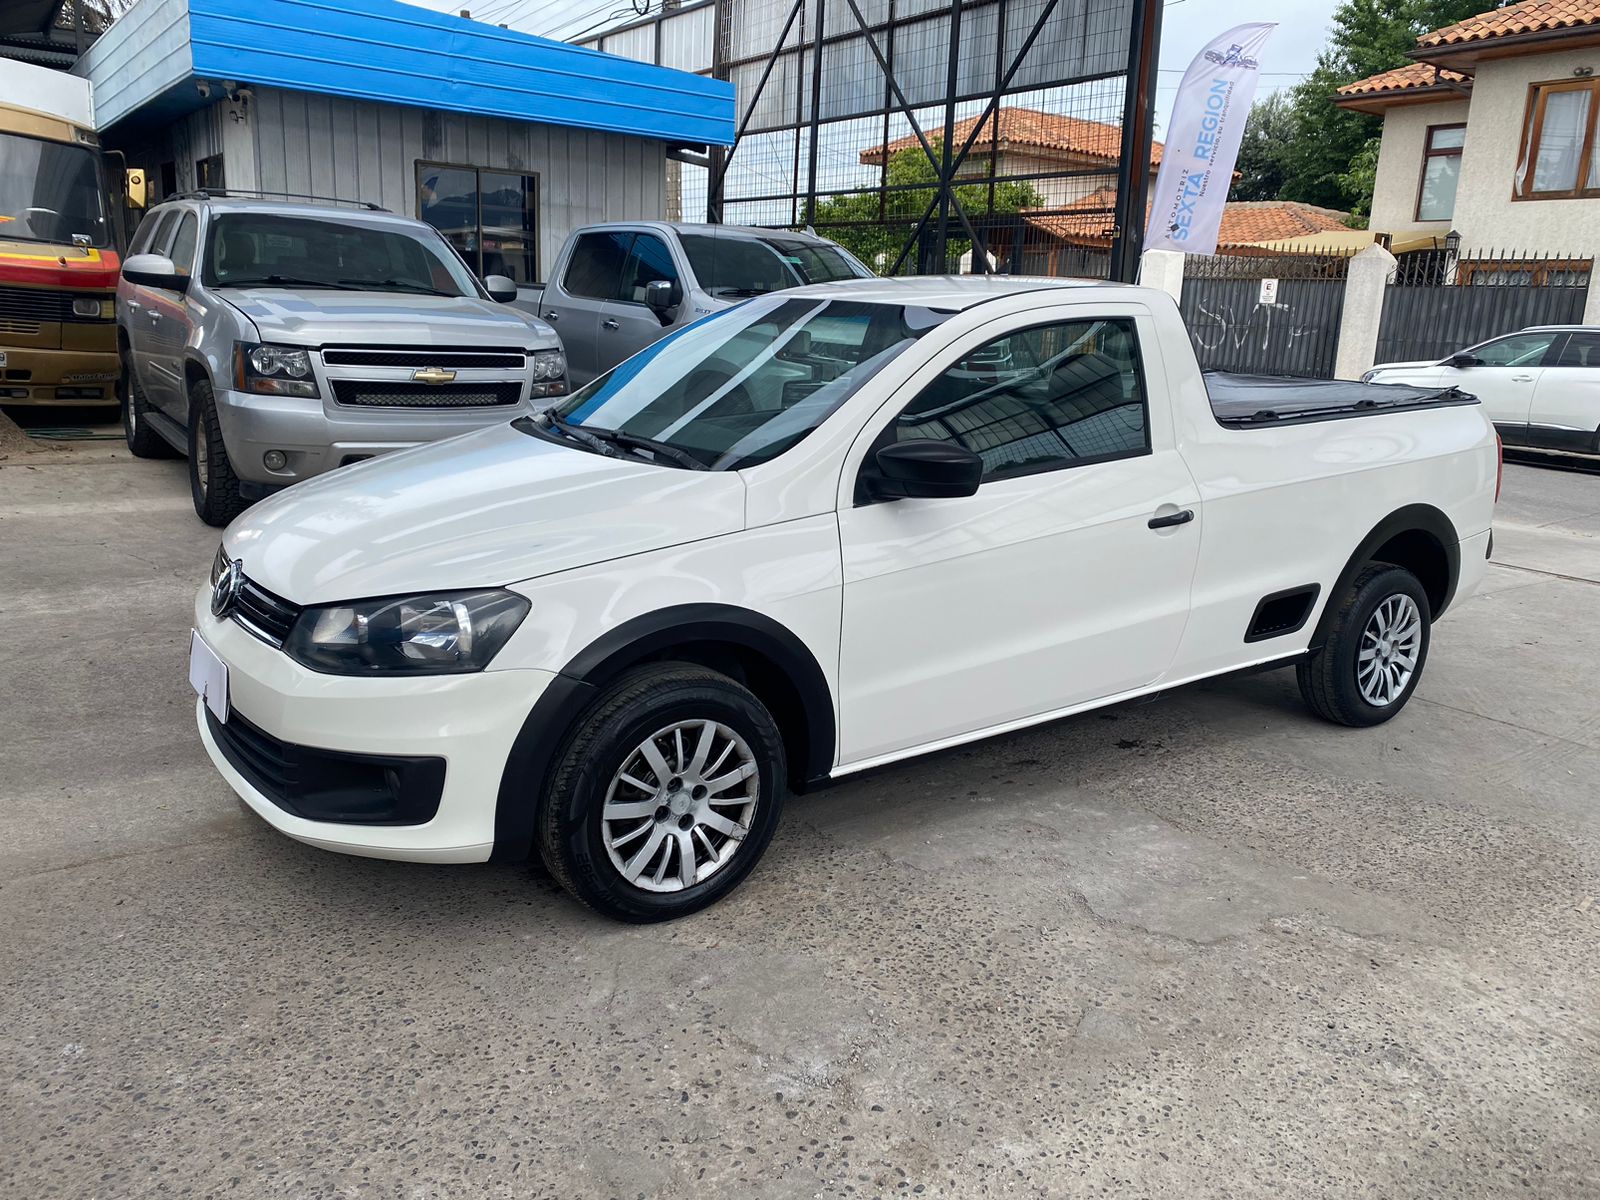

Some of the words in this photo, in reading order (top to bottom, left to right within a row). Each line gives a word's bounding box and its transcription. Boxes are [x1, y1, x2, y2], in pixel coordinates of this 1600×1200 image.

[1219, 81, 1235, 124] tranquilidad
[1217, 126, 1223, 135] su
[1172, 173, 1204, 240] SEXTA
[1194, 79, 1228, 160] REGION
[1199, 169, 1211, 197] Nuestro
